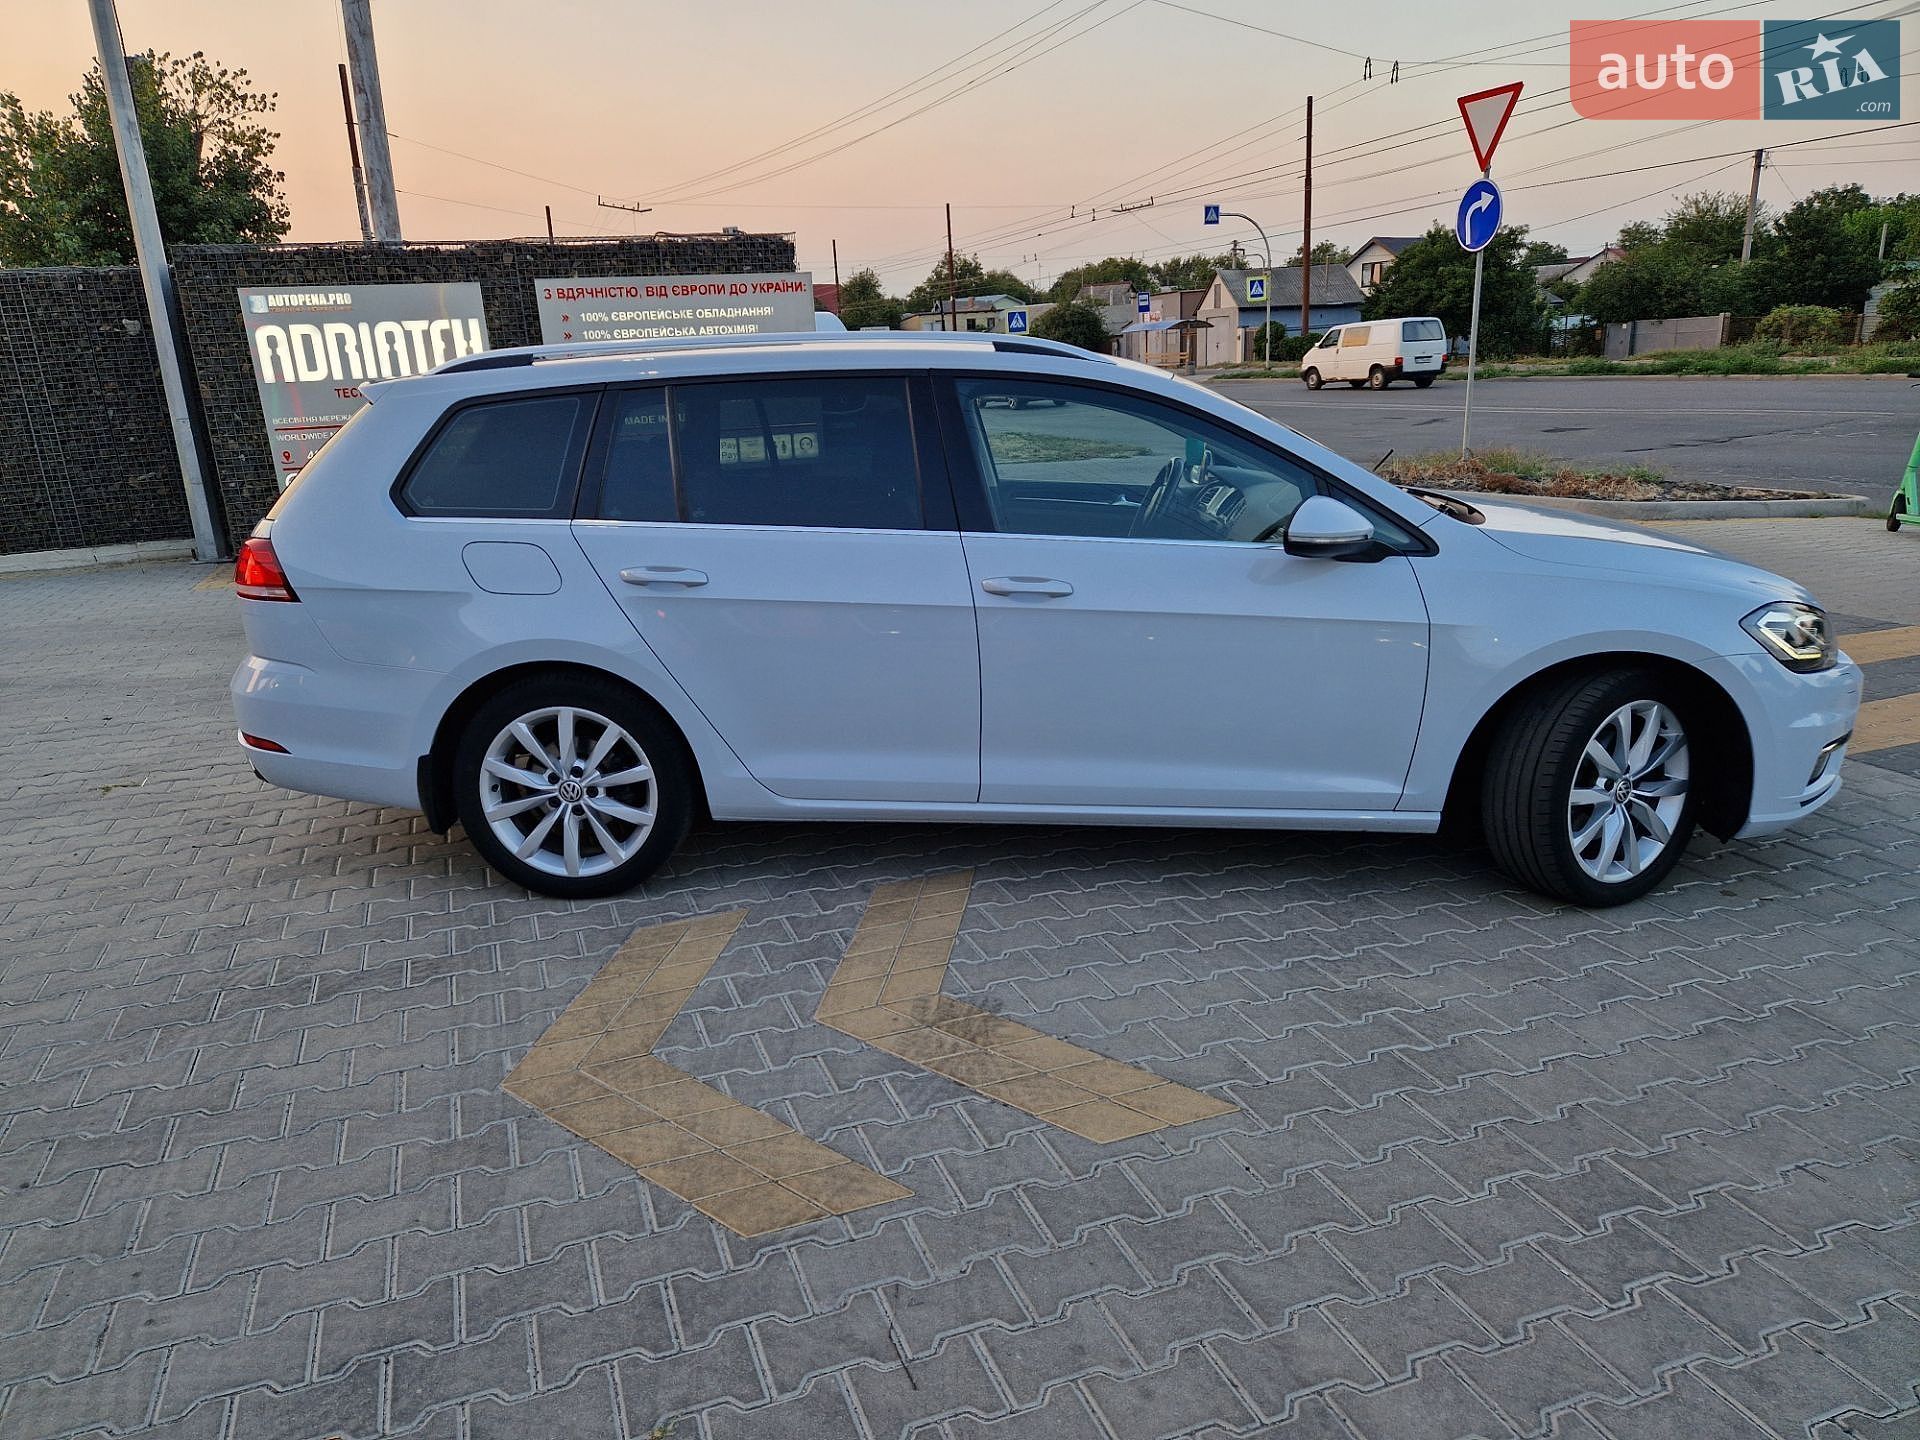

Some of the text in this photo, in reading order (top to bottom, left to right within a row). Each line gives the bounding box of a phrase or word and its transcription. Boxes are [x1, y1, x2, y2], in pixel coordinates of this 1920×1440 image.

[543, 279, 807, 301] З ВДЯЧНІСТЮ, ВІД ЄВРОПИ ДО УКРАЇНИ:
[267, 292, 352, 307] AUTOPENA.PRO
[580, 306, 774, 322] 100% ЄВРОПЕЙСЬКЕ ОБЛАДНАННЯ!
[582, 324, 759, 340] 100% ЄВРОПЕЙСЬКА АВТОХІМІЯ!
[624, 415, 656, 425] MADE
[275, 431, 329, 442] WORLDWIDE
